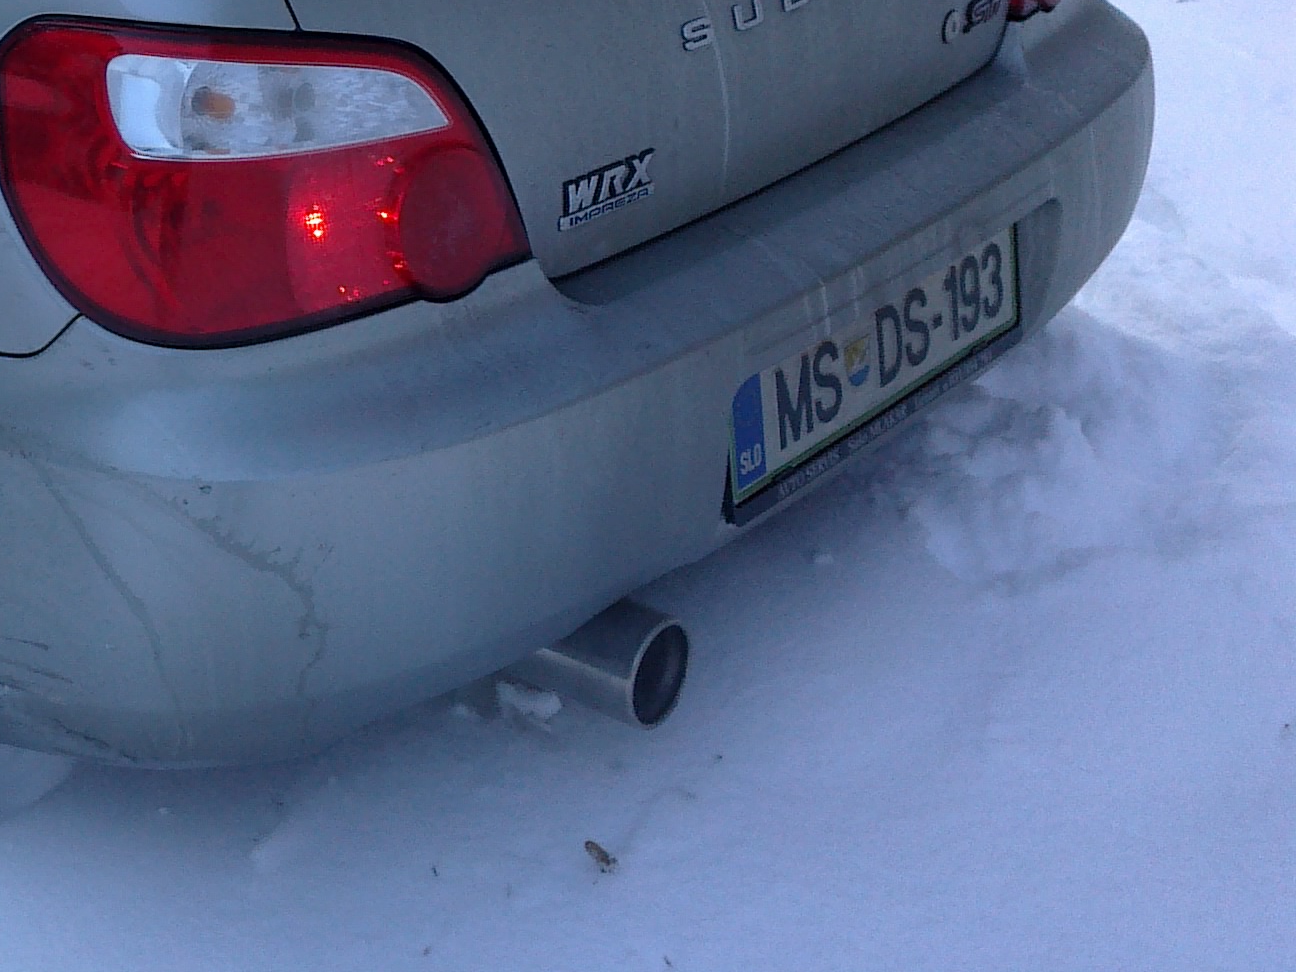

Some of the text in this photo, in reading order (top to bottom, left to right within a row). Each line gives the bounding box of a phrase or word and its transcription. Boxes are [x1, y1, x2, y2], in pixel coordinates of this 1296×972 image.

[564, 148, 655, 216] WRX
[568, 186, 650, 227] IMPREZA
[773, 340, 843, 451] MS
[874, 242, 1004, 389] DS-193
[739, 443, 762, 476] SLO
